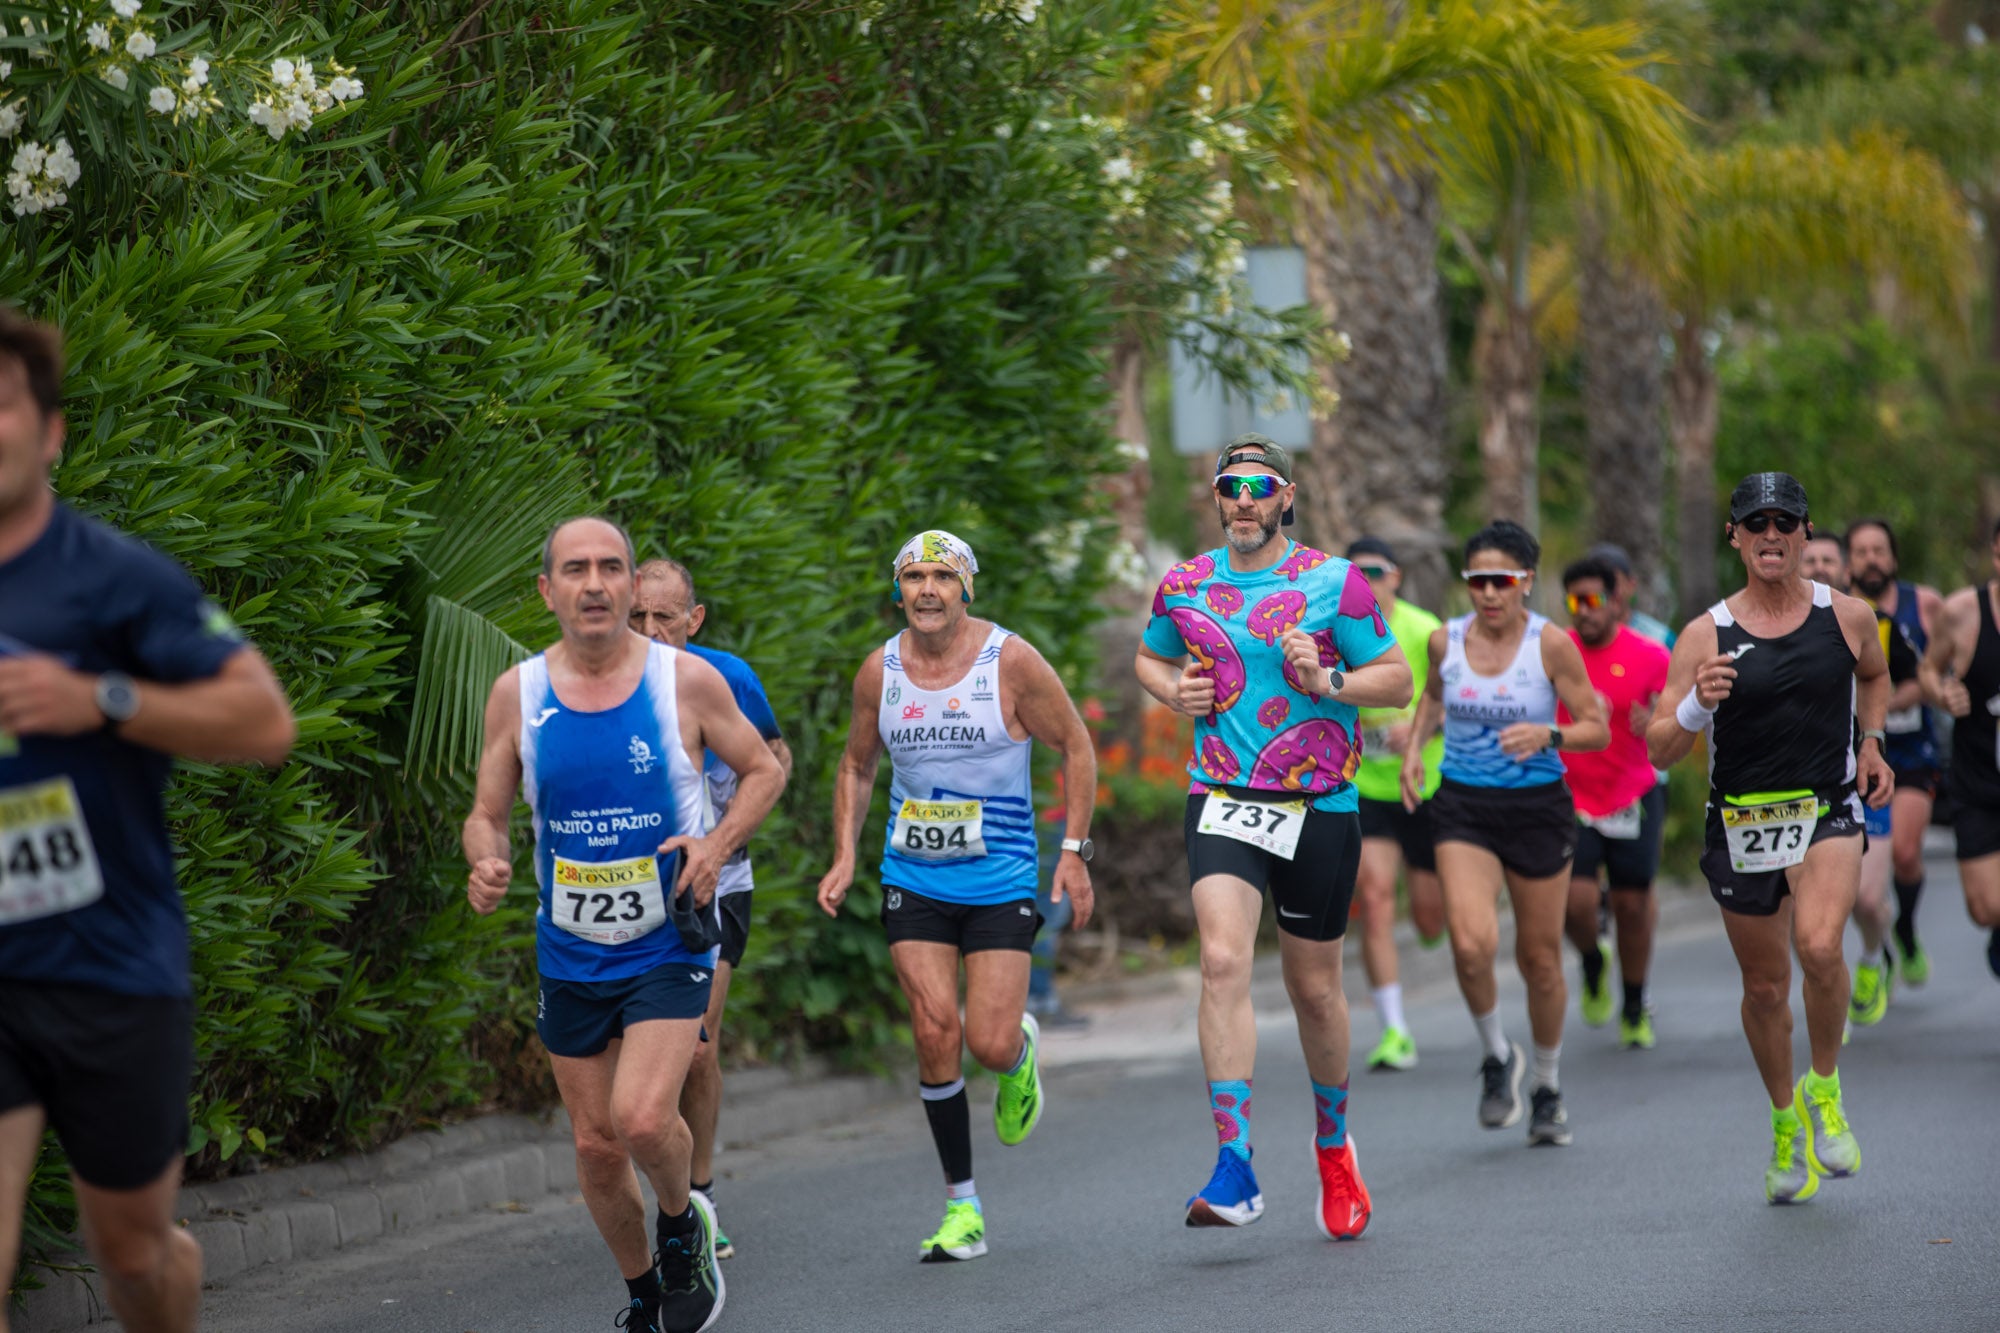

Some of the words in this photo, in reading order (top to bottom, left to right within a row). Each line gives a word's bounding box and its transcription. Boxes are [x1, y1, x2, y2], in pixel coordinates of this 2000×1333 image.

[1450, 703, 1526, 718] MARACENA
[890, 726, 986, 745] MARACENA
[549, 819, 593, 834] PAZITO
[597, 821, 608, 833] a
[611, 812, 662, 832] PAZITO
[571, 810, 588, 818] Club
[589, 809, 599, 817] de
[601, 807, 634, 816] Atletismo
[1221, 802, 1288, 835] 737
[588, 834, 619, 847] Motril
[905, 825, 968, 851] 694
[1742, 825, 1803, 854] 273
[0, 826, 83, 882] 48
[565, 865, 577, 881] 38
[566, 890, 645, 923] 723
